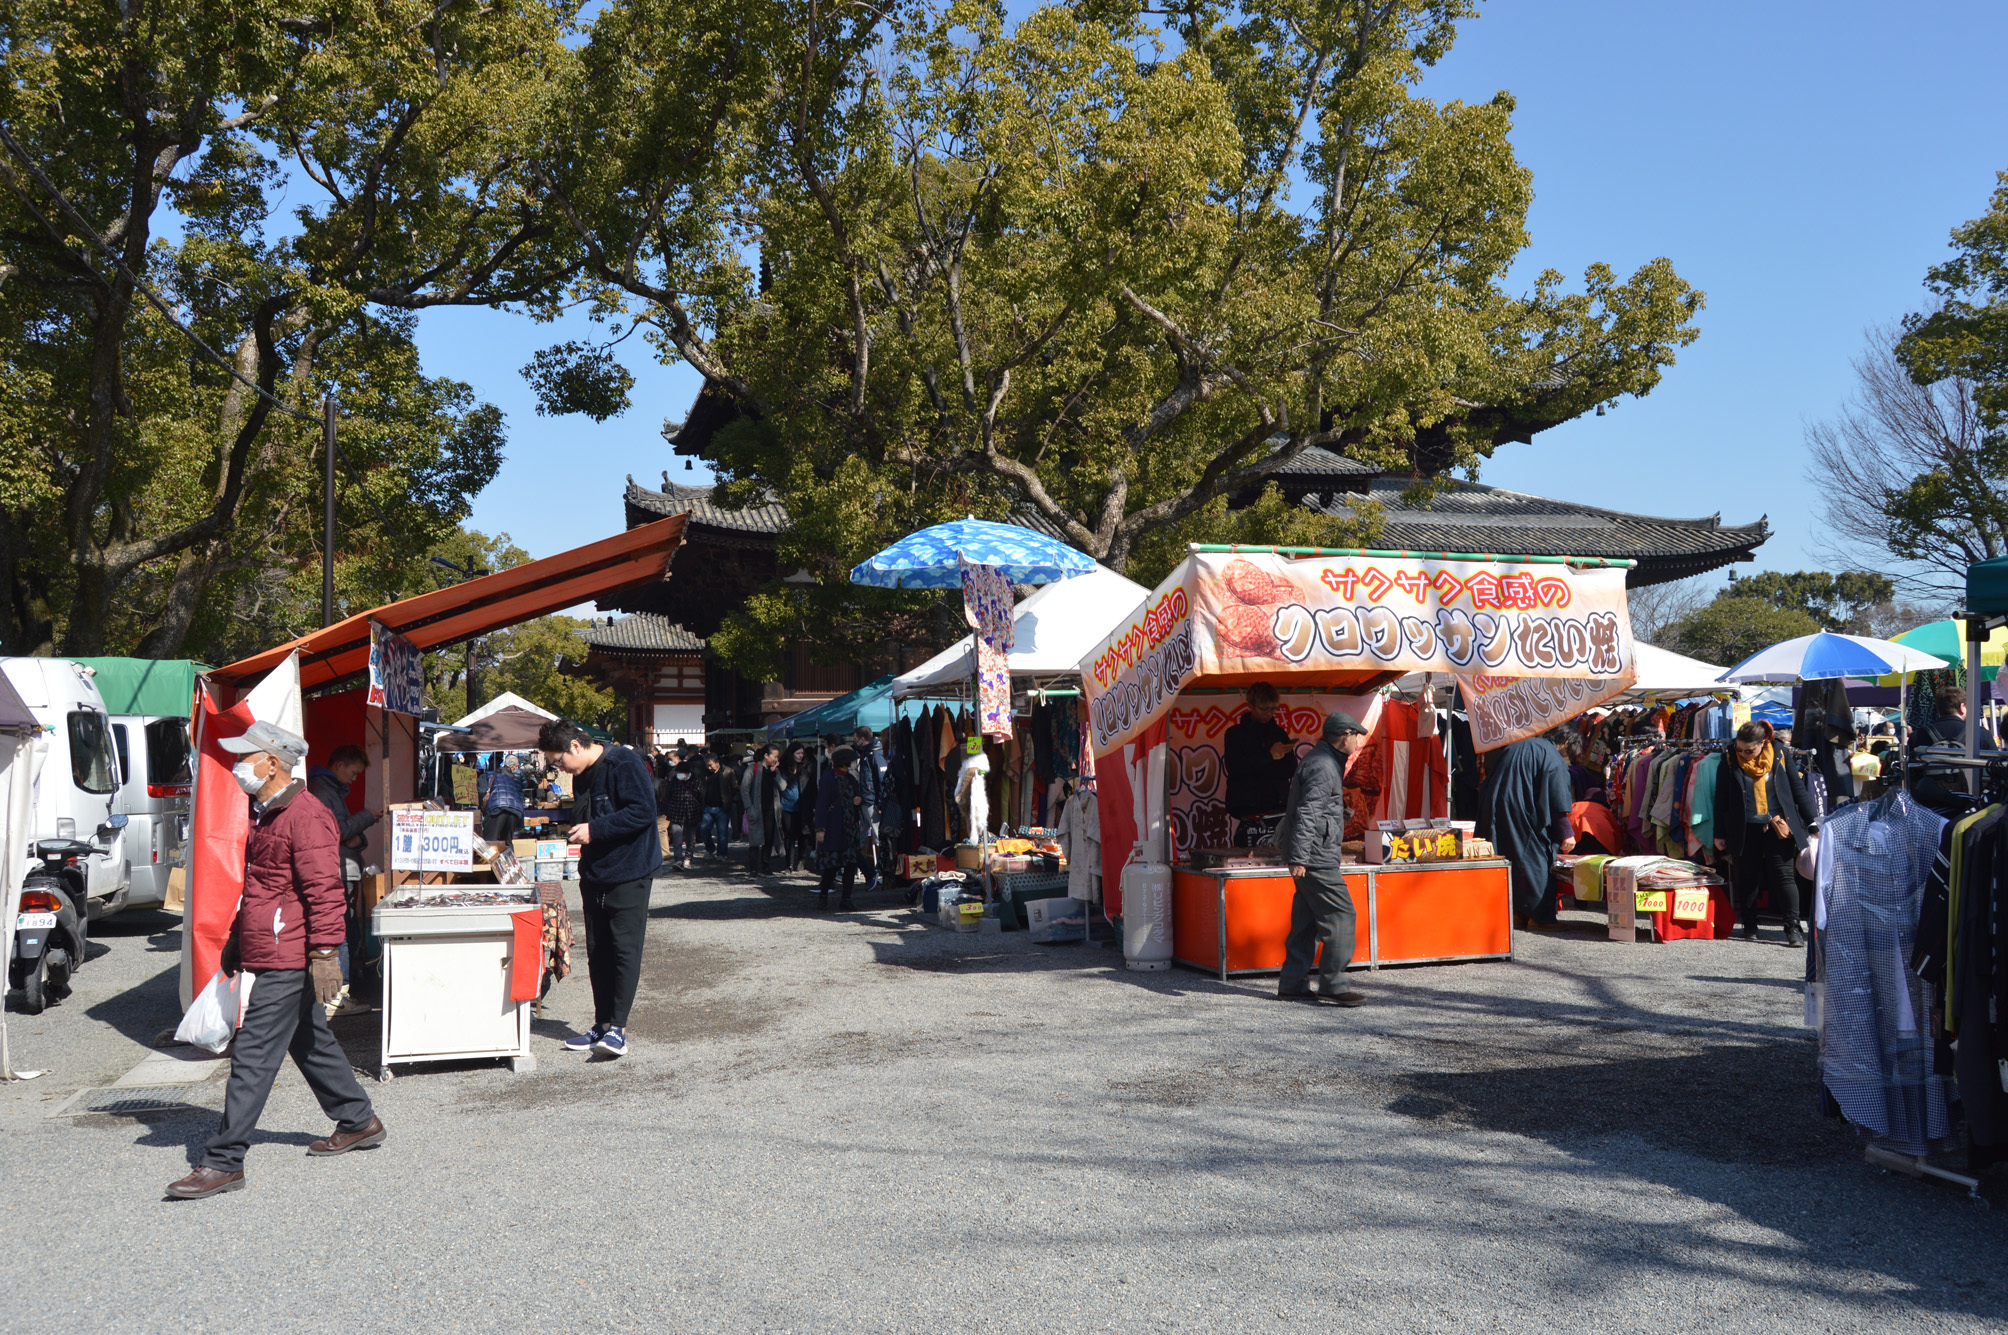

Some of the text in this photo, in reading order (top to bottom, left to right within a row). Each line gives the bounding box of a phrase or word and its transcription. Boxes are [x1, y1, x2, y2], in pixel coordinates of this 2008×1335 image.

[1321, 567, 1572, 611] サクサク食感の
[1094, 585, 1189, 688] サクサク食感の
[1273, 605, 1621, 674] クロワッサンたい焼
[425, 814, 469, 825] OUTLET
[1390, 833, 1457, 859] たい焼
[1677, 900, 1705, 912] 1000
